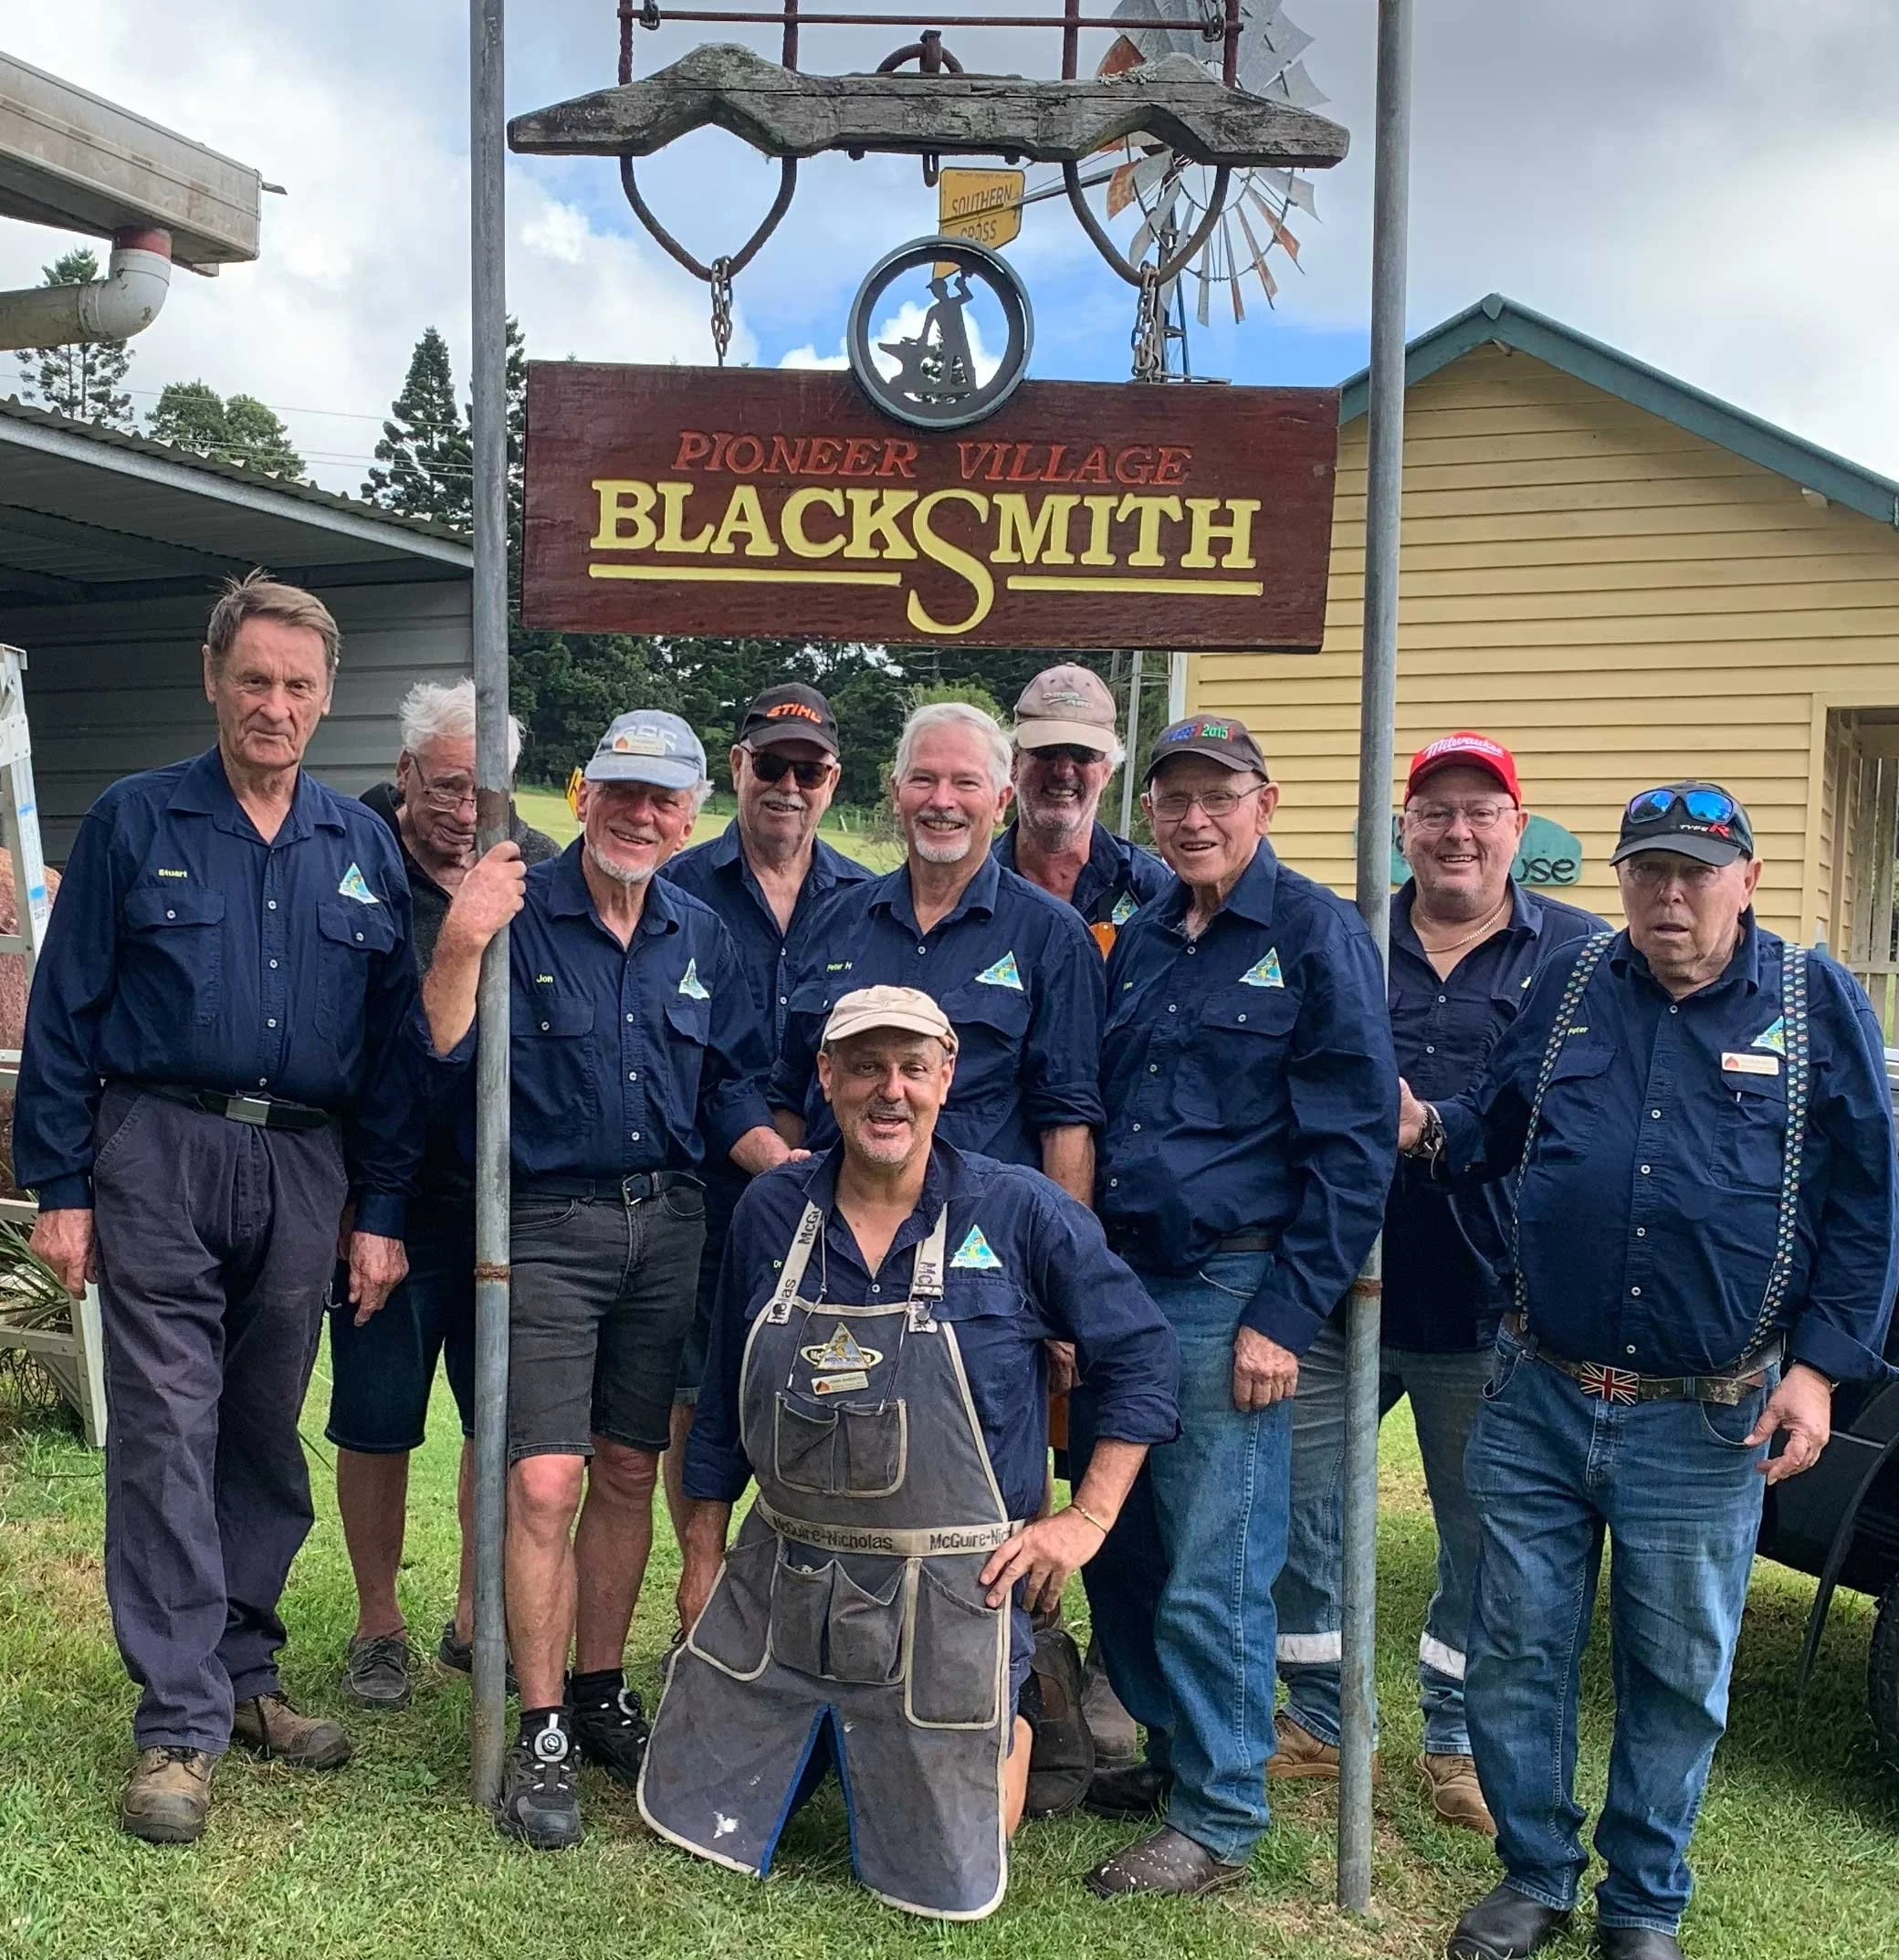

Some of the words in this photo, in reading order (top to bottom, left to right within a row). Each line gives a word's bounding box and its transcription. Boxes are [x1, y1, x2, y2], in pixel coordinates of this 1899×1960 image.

[951, 183, 1013, 218] SOUTHERN
[671, 430, 918, 477] PIONEER
[957, 440, 1193, 486] VILLAGE
[589, 478, 1263, 634] BLACKSMITH
[766, 702, 822, 724] STIHL
[1201, 723, 1229, 739] 2015
[1422, 736, 1506, 760] Milwaukee
[158, 868, 188, 878] Stuart
[536, 973, 553, 984] Jon
